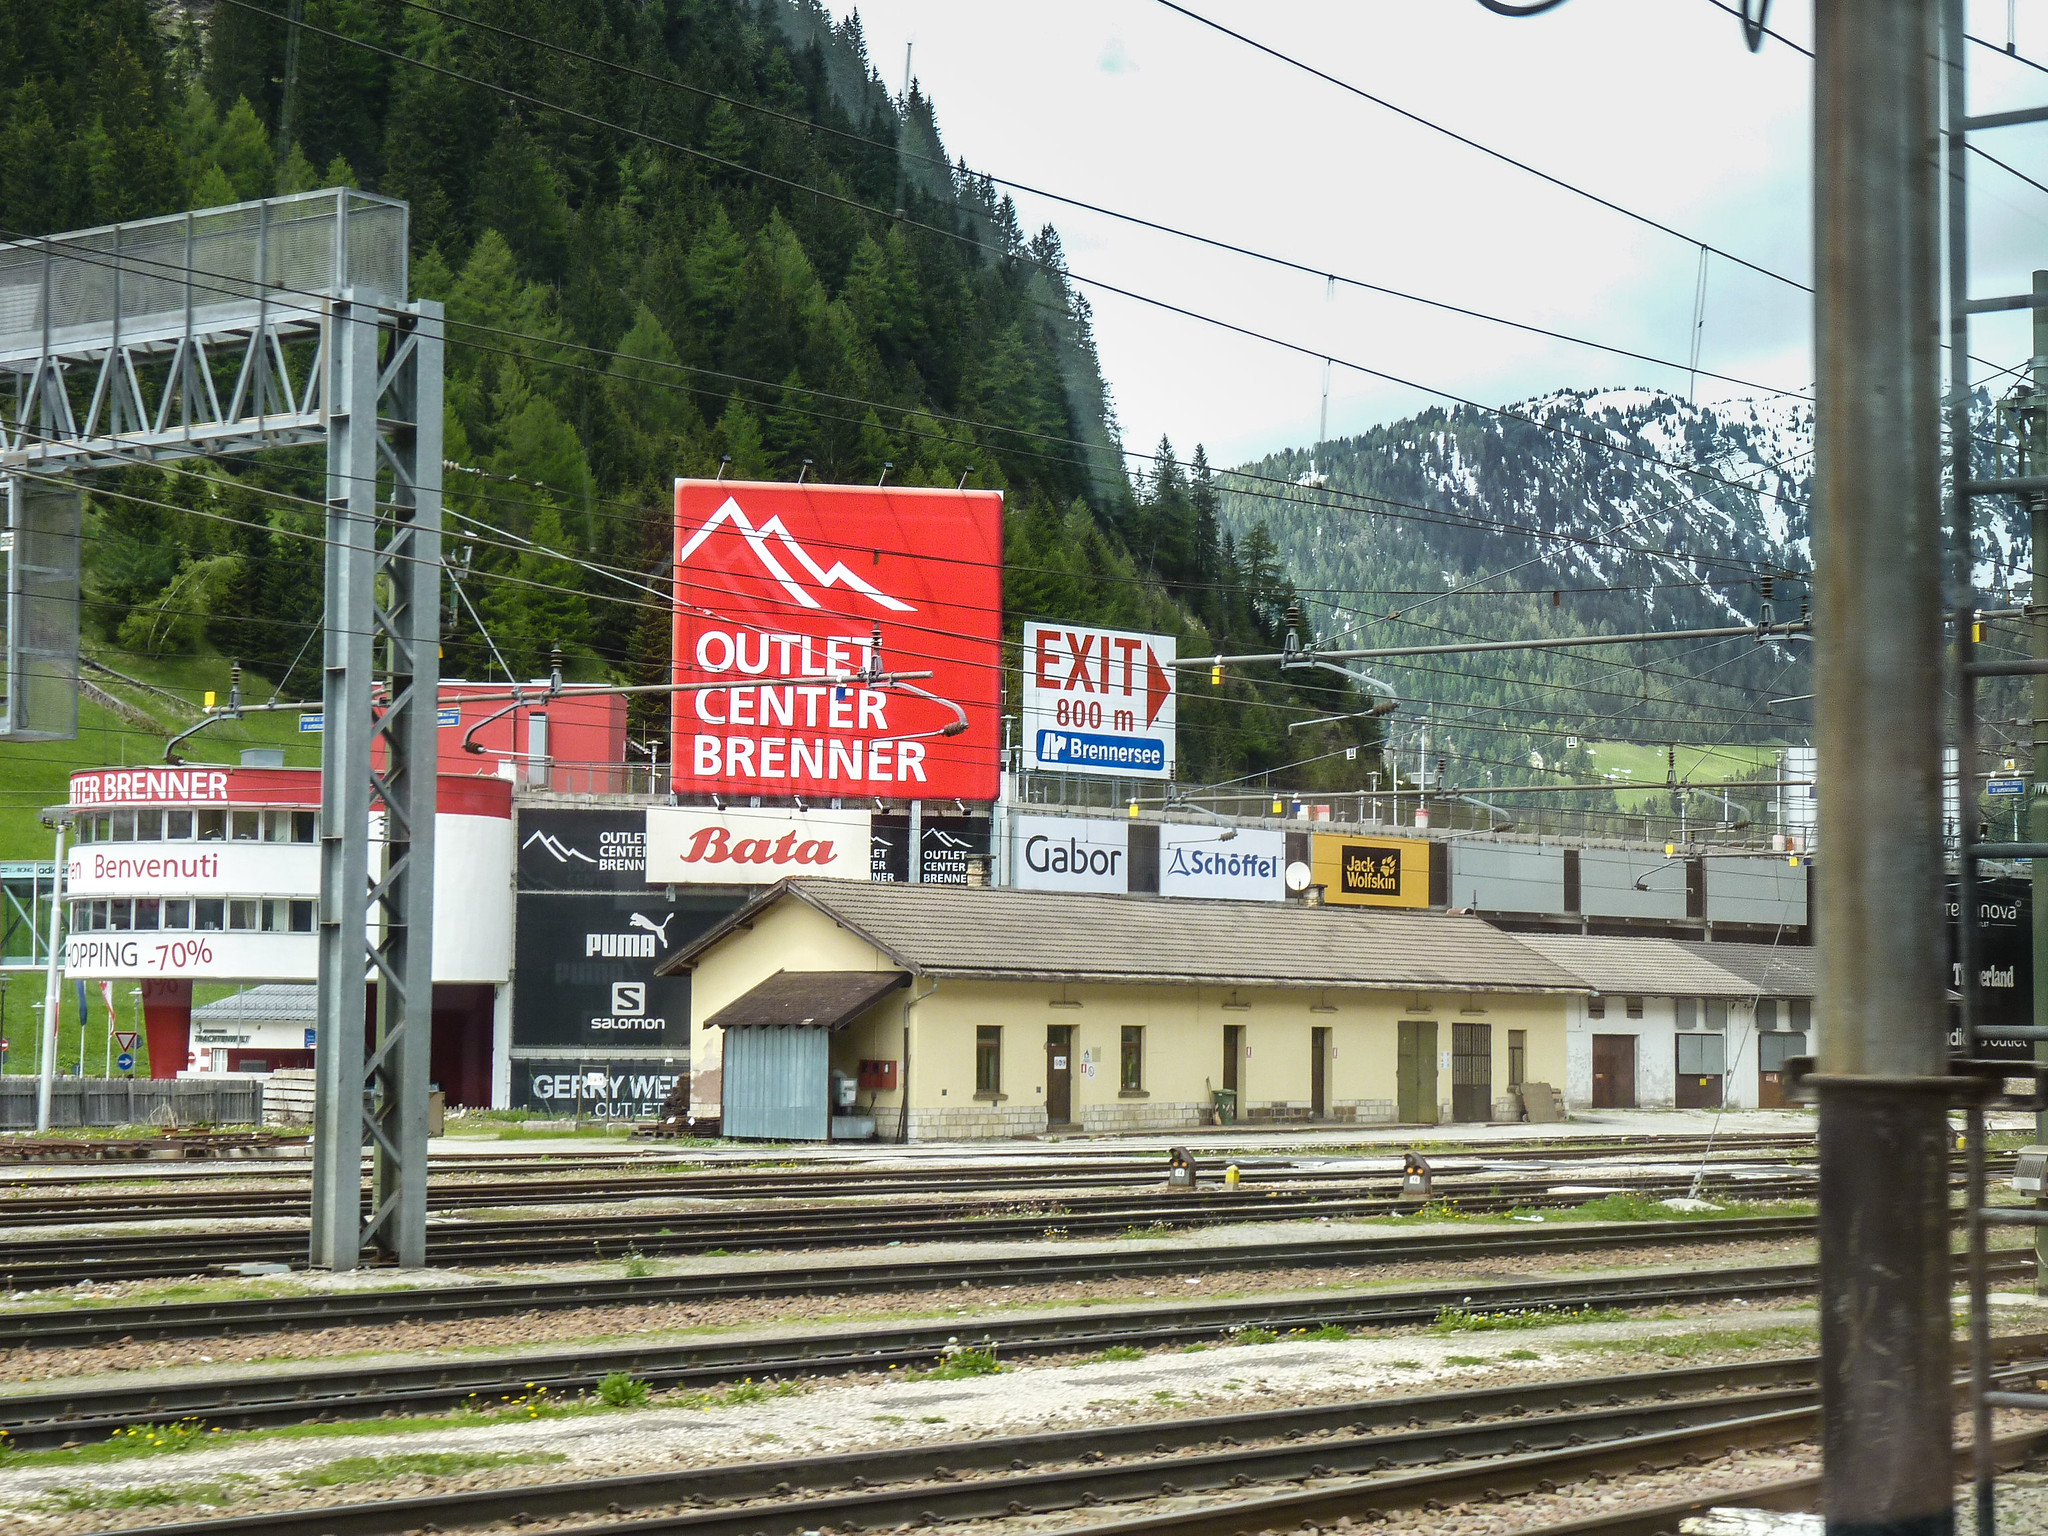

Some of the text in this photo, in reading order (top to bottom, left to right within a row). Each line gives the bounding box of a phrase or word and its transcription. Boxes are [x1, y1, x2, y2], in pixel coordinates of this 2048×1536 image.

[696, 630, 883, 676] OUTLET
[1036, 629, 1141, 696] EXIT
[694, 686, 888, 730] CENTER
[1057, 698, 1134, 732] 800 m
[694, 735, 927, 782] BRENNER
[1070, 738, 1160, 764] Brennersee
[104, 771, 228, 801] BRENNER
[680, 826, 838, 865] Bata
[924, 850, 967, 860] OUTLET
[1025, 835, 1122, 876] Gabor
[95, 853, 218, 879] Benvenuti
[599, 858, 645, 871] BRENN
[924, 862, 966, 872] CENTER
[1191, 850, 1276, 878] Schöffel
[1346, 855, 1375, 872] Jack
[923, 873, 967, 883] BRENNE
[1346, 871, 1396, 890] Wolfskin
[147, 938, 213, 971] -70%
[586, 933, 656, 957] PUMA
[595, 1102, 665, 1118] OUTLET
